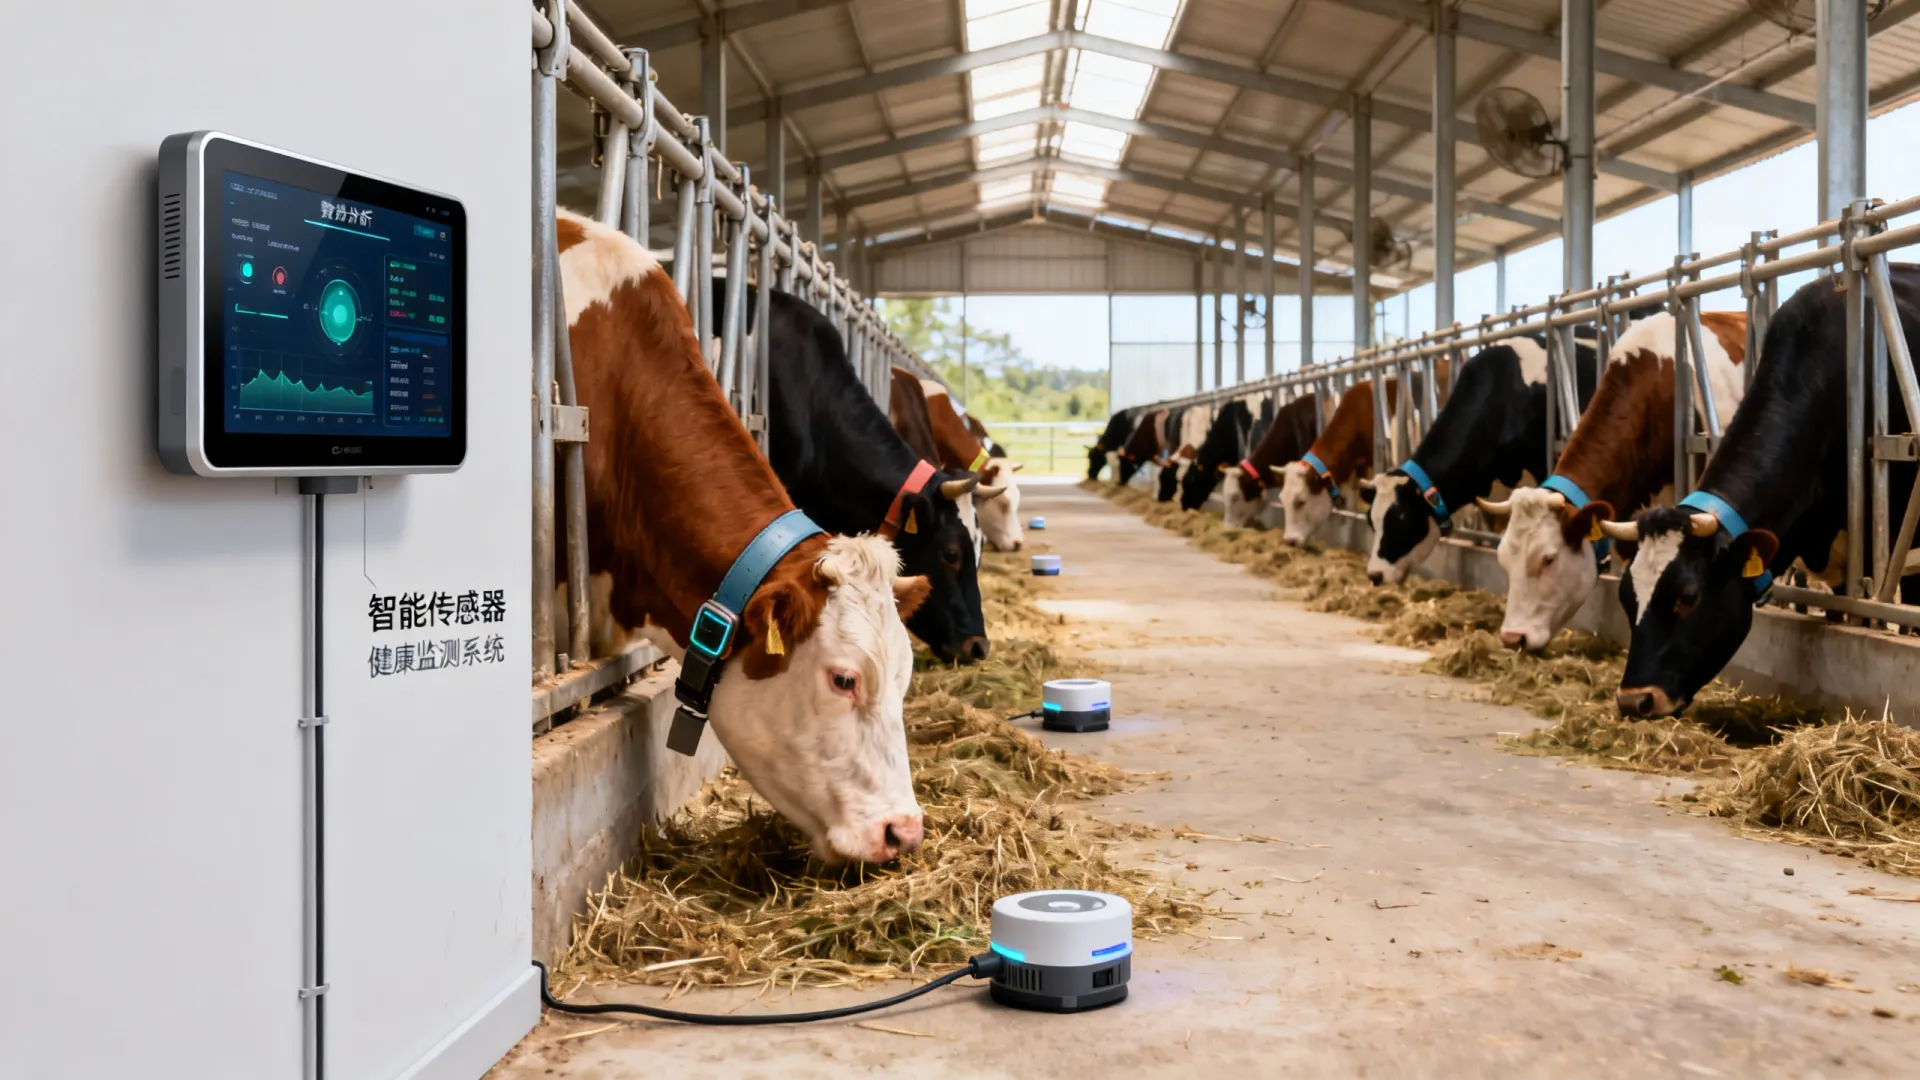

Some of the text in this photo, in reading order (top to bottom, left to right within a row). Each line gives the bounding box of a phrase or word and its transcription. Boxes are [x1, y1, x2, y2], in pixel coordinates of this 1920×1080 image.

[368, 589, 506, 632] 智能传感器
[368, 633, 505, 678] 健康监测系统
